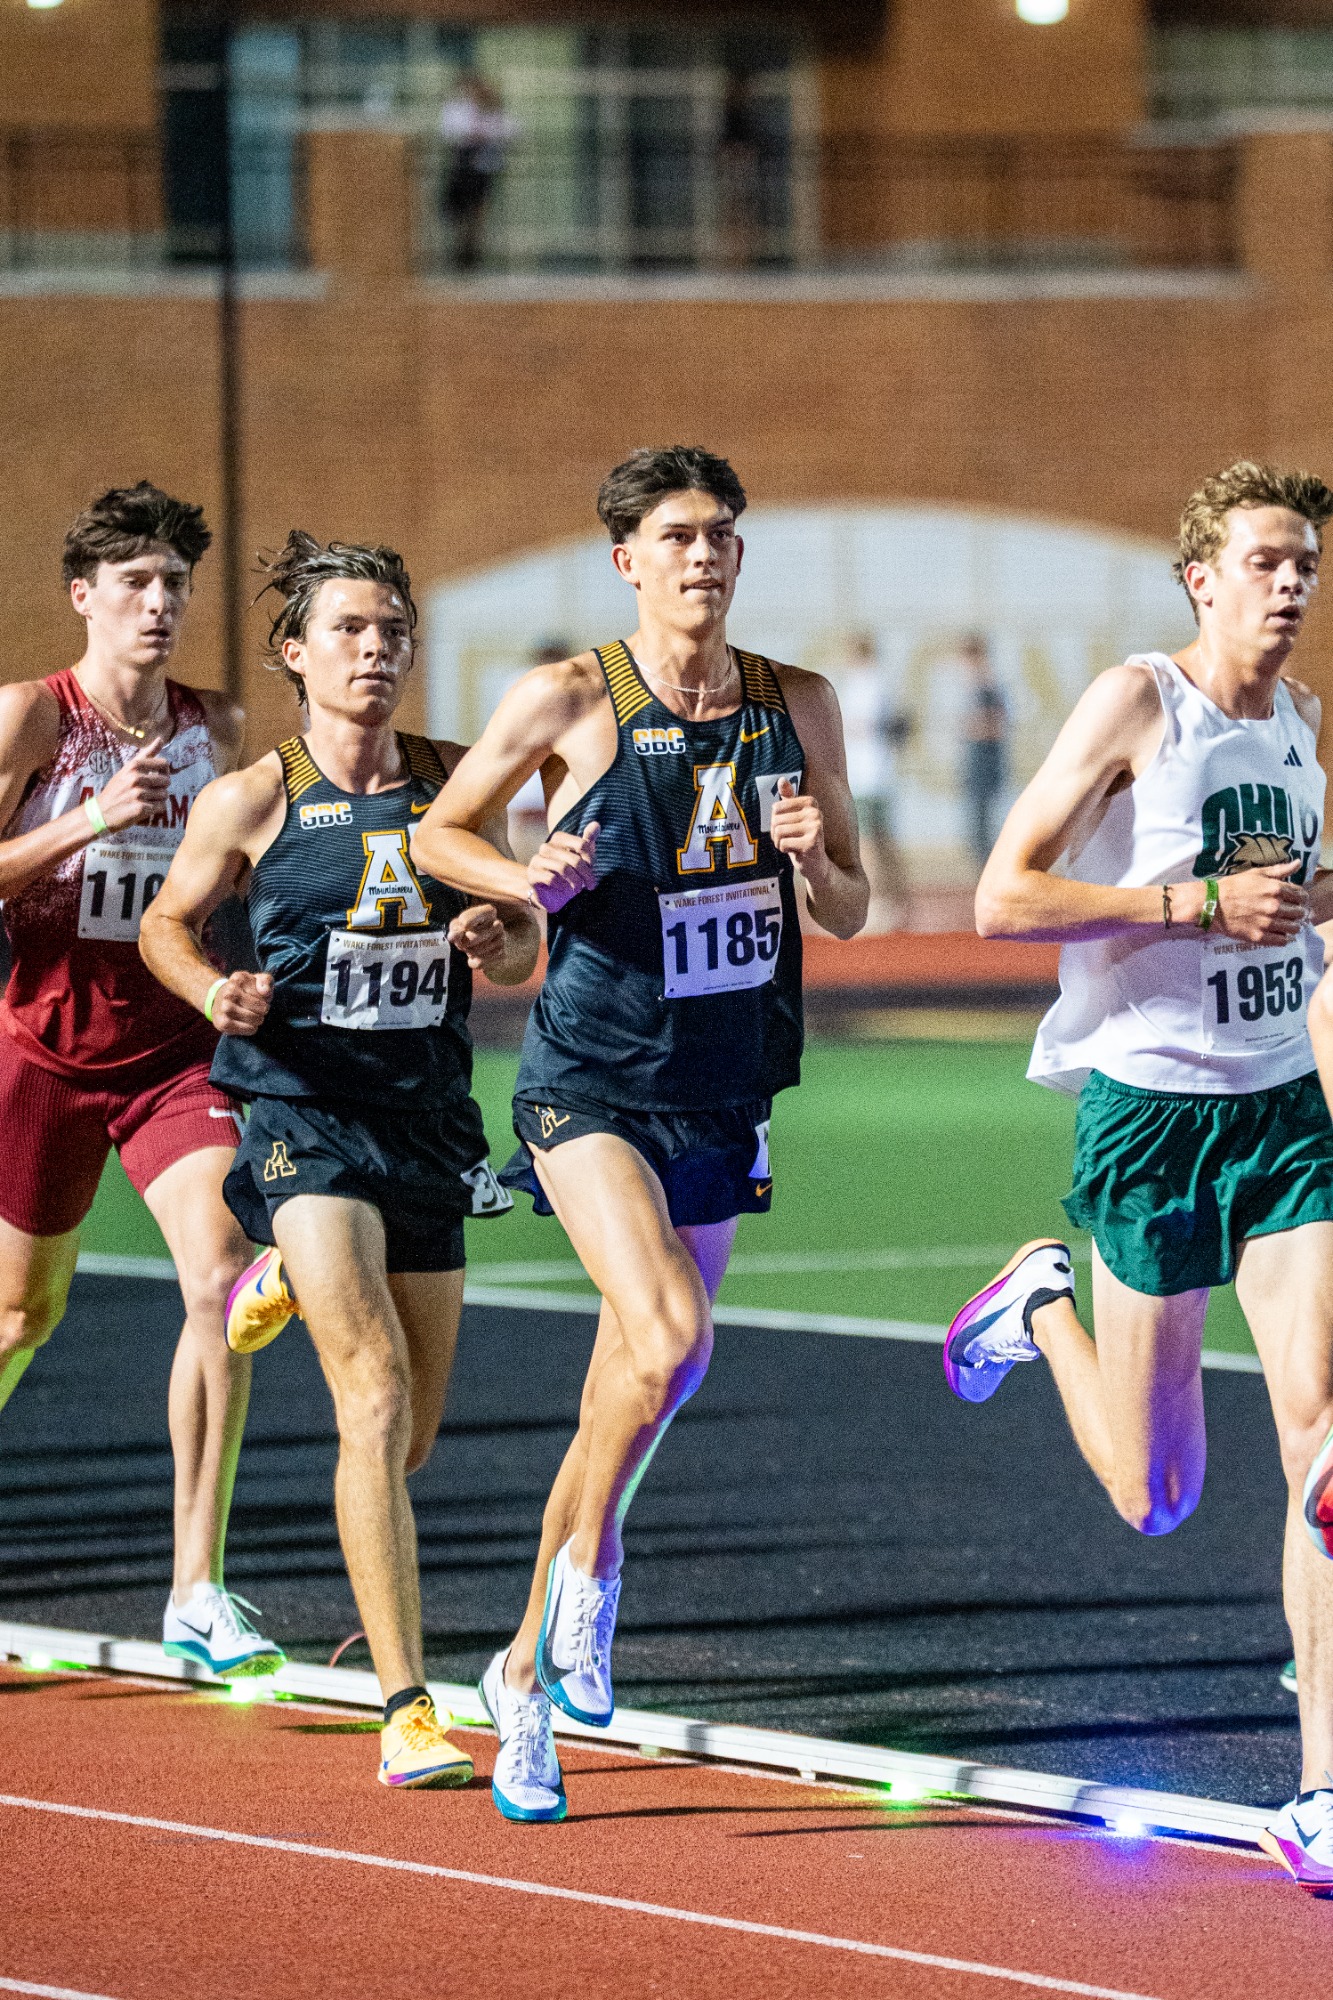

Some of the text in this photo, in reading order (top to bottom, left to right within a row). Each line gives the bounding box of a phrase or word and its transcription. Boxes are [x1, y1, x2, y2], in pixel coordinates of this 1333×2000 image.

[632, 727, 686, 756] SBC
[299, 802, 353, 830] SBC
[676, 761, 759, 875] A
[346, 829, 433, 932] A
[367, 884, 413, 896] Mountaineers
[673, 886, 770, 908] WAKE FOREST INVITATIONAL
[343, 938, 440, 951] WAKE FOREST INVITATIONAL
[666, 906, 781, 975] 1185
[330, 958, 447, 1008] 1194
[1207, 956, 1304, 1025] 1953
[264, 1140, 297, 1182] A
